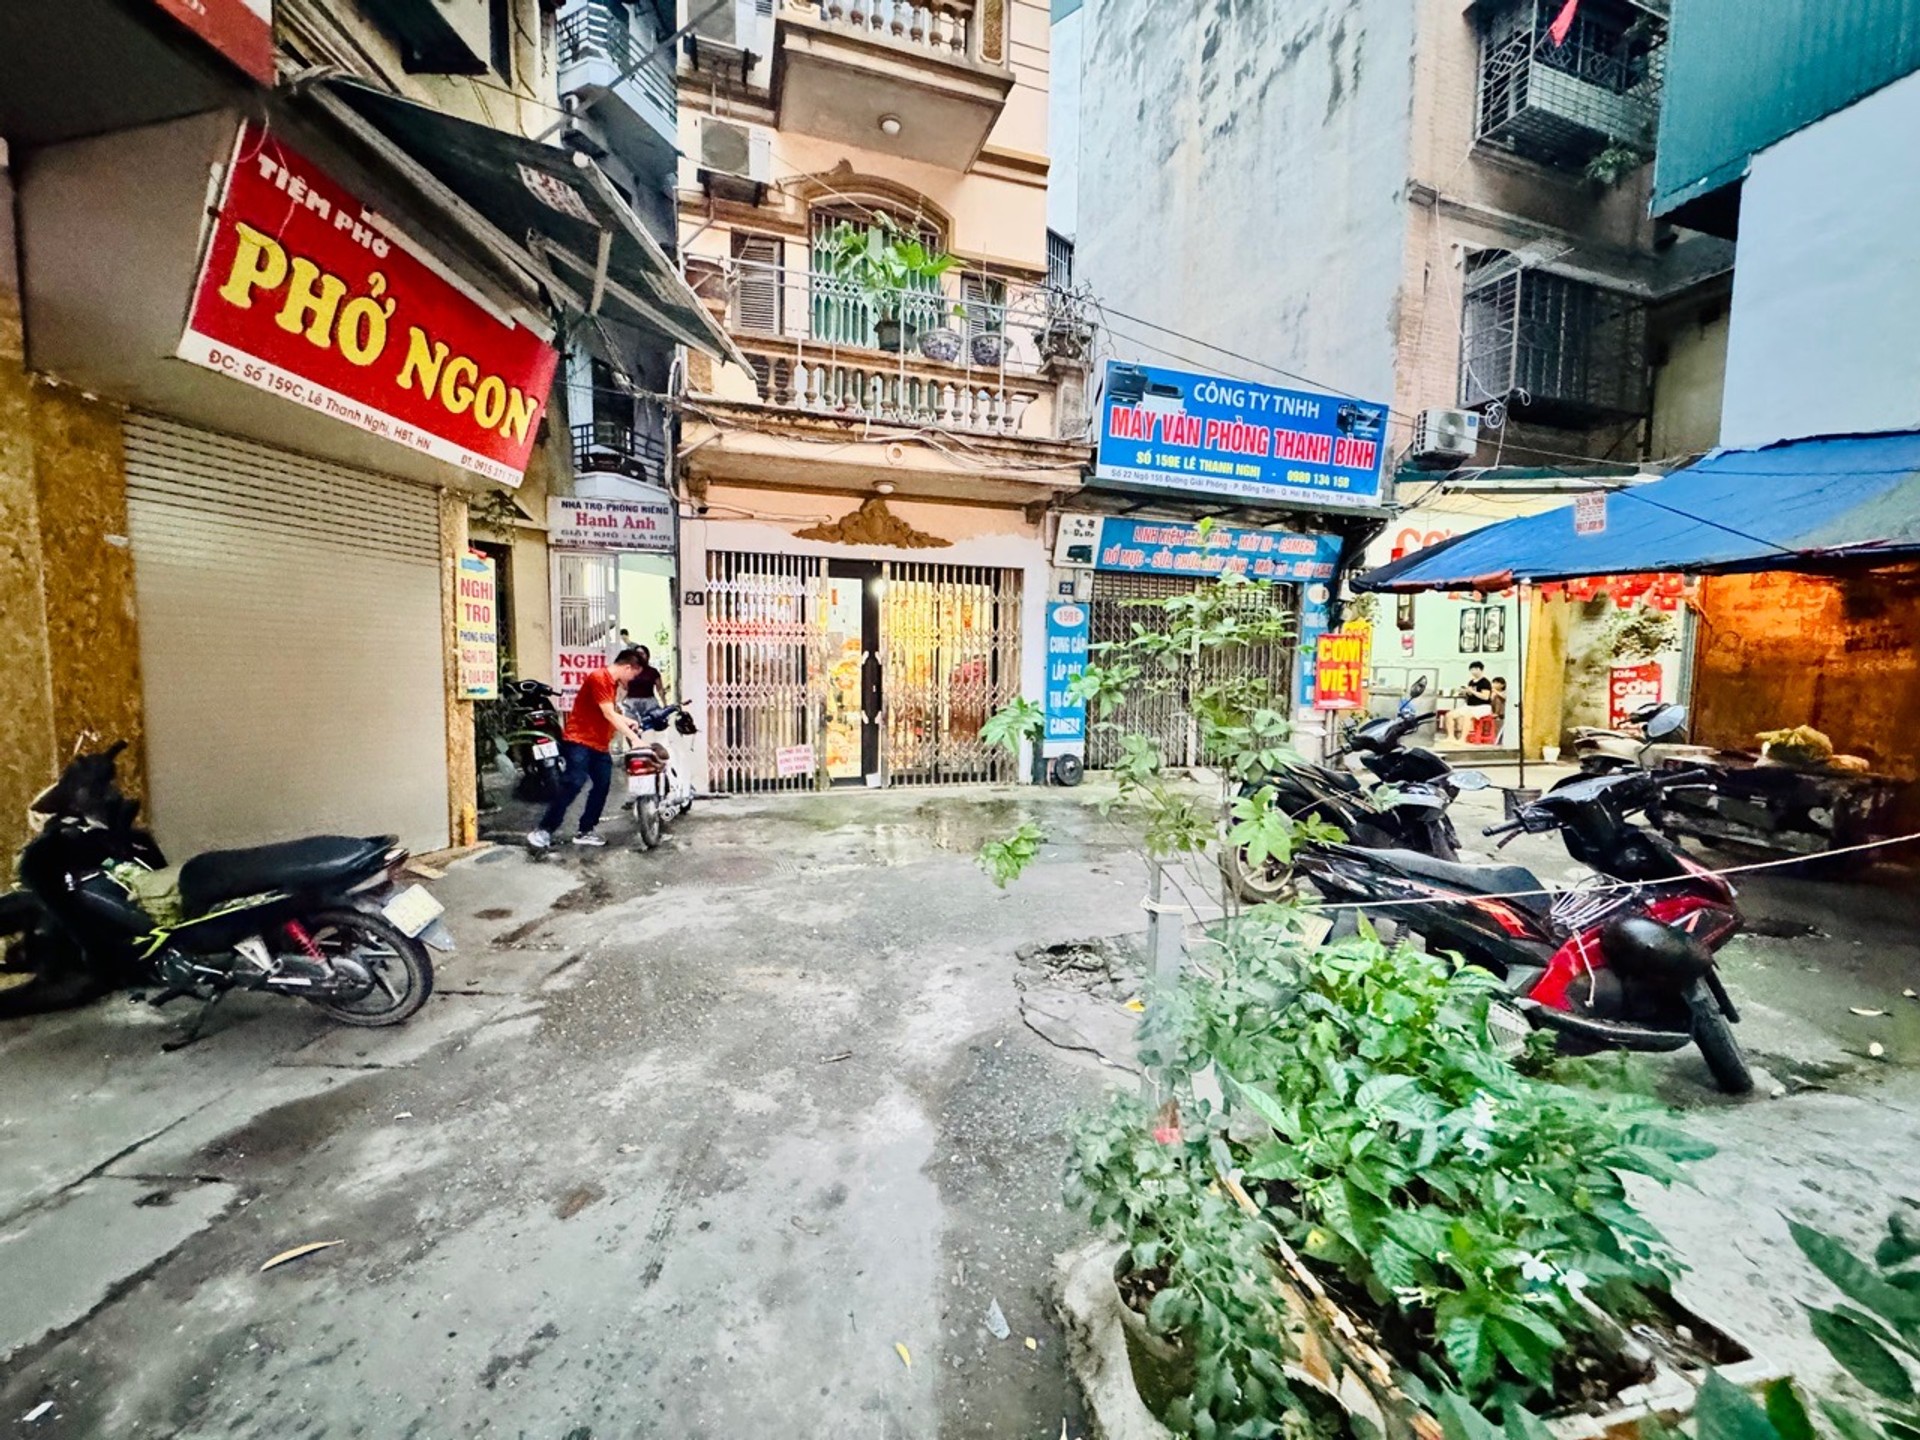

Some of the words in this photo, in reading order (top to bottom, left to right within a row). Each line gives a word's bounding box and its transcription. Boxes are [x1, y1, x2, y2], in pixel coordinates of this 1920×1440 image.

[218, 221, 396, 366] PHỞ
[396, 326, 539, 446] NGON
[208, 349, 240, 373] ĐC:
[243, 363, 267, 382] Số
[307, 390, 323, 406] Lê
[325, 397, 361, 421] Thanh
[416, 434, 432, 450] HN
[1193, 380, 1245, 408] CÔNG
[1248, 391, 1271, 412] TY
[1272, 395, 1320, 419] TNHH
[1109, 402, 1155, 441] MÁY
[1161, 410, 1201, 449] VĂN
[1204, 414, 1270, 458] PHÒNG
[1274, 427, 1332, 464] THANH
[1334, 432, 1376, 471] BÌNH
[1111, 468, 1121, 478] Số
[1136, 448, 1153, 465] SỐ
[1183, 455, 1197, 471] LÊ
[1199, 458, 1233, 475] THANH
[1235, 463, 1261, 481] NGHỊ
[623, 515, 656, 531] Anh
[687, 593, 701, 605] 24
[1061, 583, 1073, 593] 22
[1319, 636, 1361, 663] CƠM
[1319, 664, 1360, 697] VIỆT
[1613, 679, 1659, 696] CƠM
